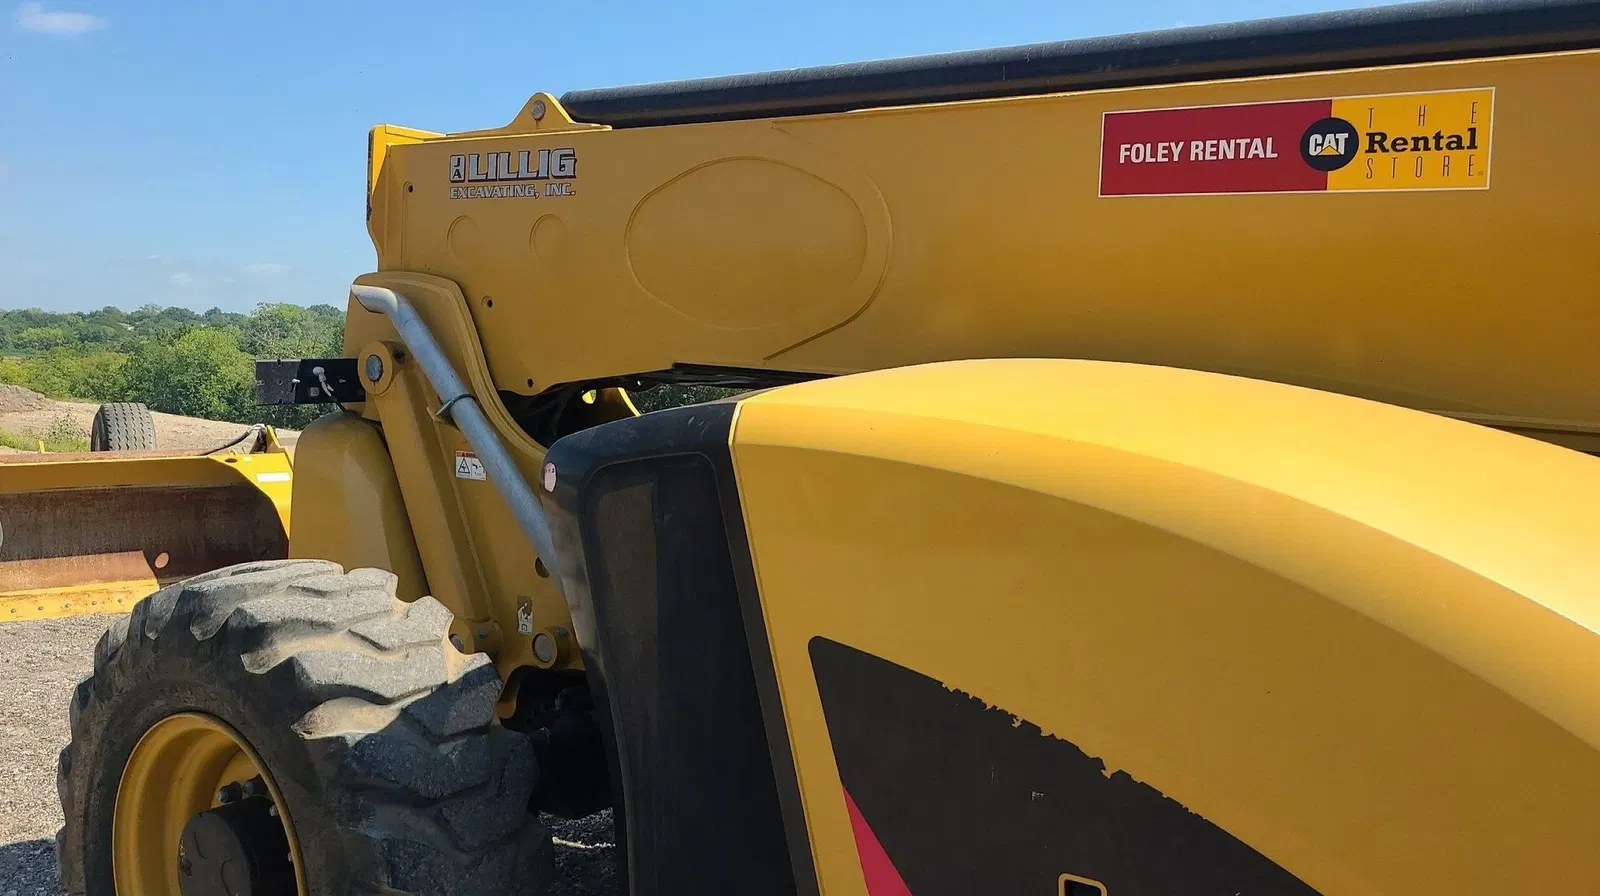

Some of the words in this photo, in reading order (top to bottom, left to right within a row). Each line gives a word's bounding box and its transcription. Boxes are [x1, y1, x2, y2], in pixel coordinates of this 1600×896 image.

[1367, 101, 1478, 129] THE
[1119, 142, 1184, 164] FOLEY
[1190, 137, 1278, 161] RENTAL
[1308, 132, 1350, 157] CAT
[1365, 128, 1478, 154] Rental
[468, 148, 577, 181] LILLIG
[450, 184, 540, 199] EXCAVATING,
[545, 183, 576, 196] INC.
